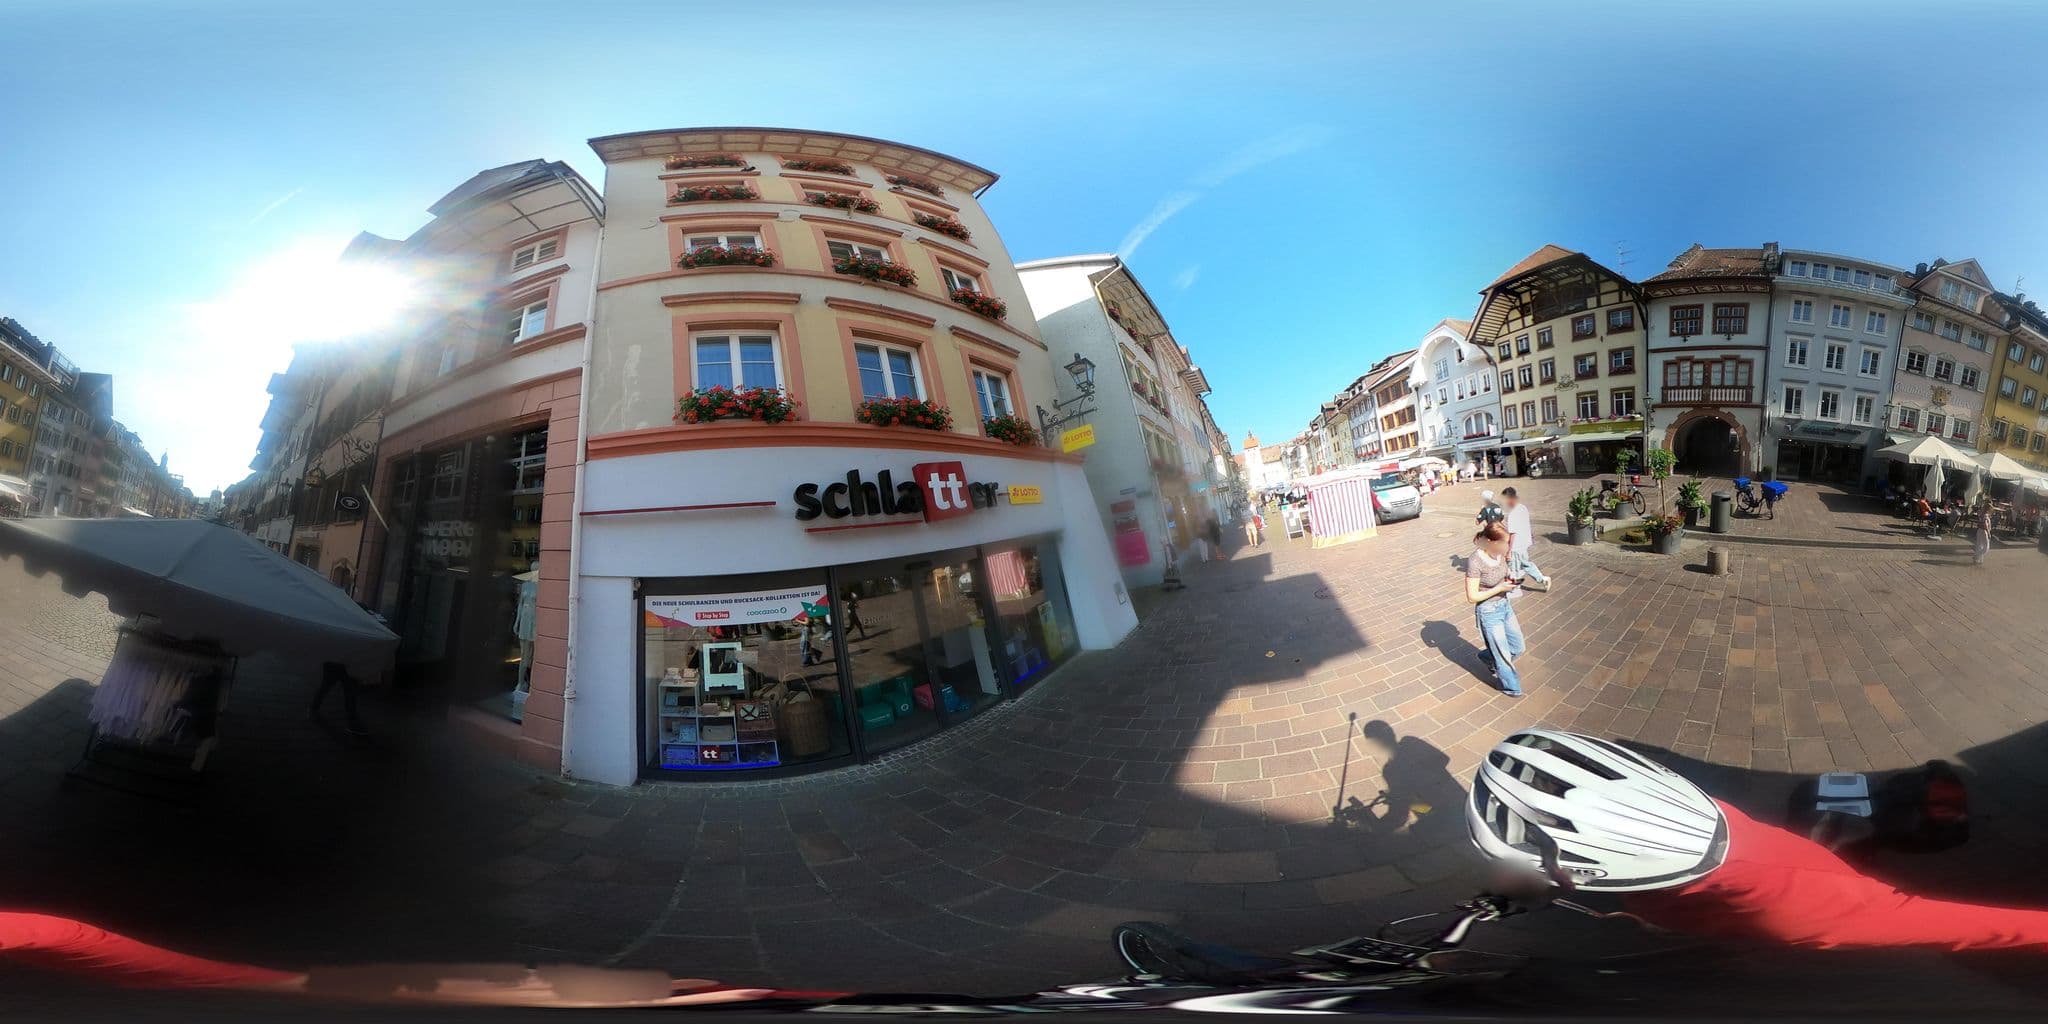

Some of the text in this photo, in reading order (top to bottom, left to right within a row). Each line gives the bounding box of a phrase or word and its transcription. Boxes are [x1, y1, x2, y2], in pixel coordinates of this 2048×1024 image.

[1071, 430, 1092, 442] LOTTO
[793, 468, 1000, 521] schlatter
[1019, 487, 1040, 497] LOTTO
[734, 593, 800, 603] RUCKSACK-KOLLEKTION
[702, 611, 712, 619] Step
[713, 611, 718, 619] by
[746, 608, 780, 616] coocazoo
[703, 750, 718, 759] tt
